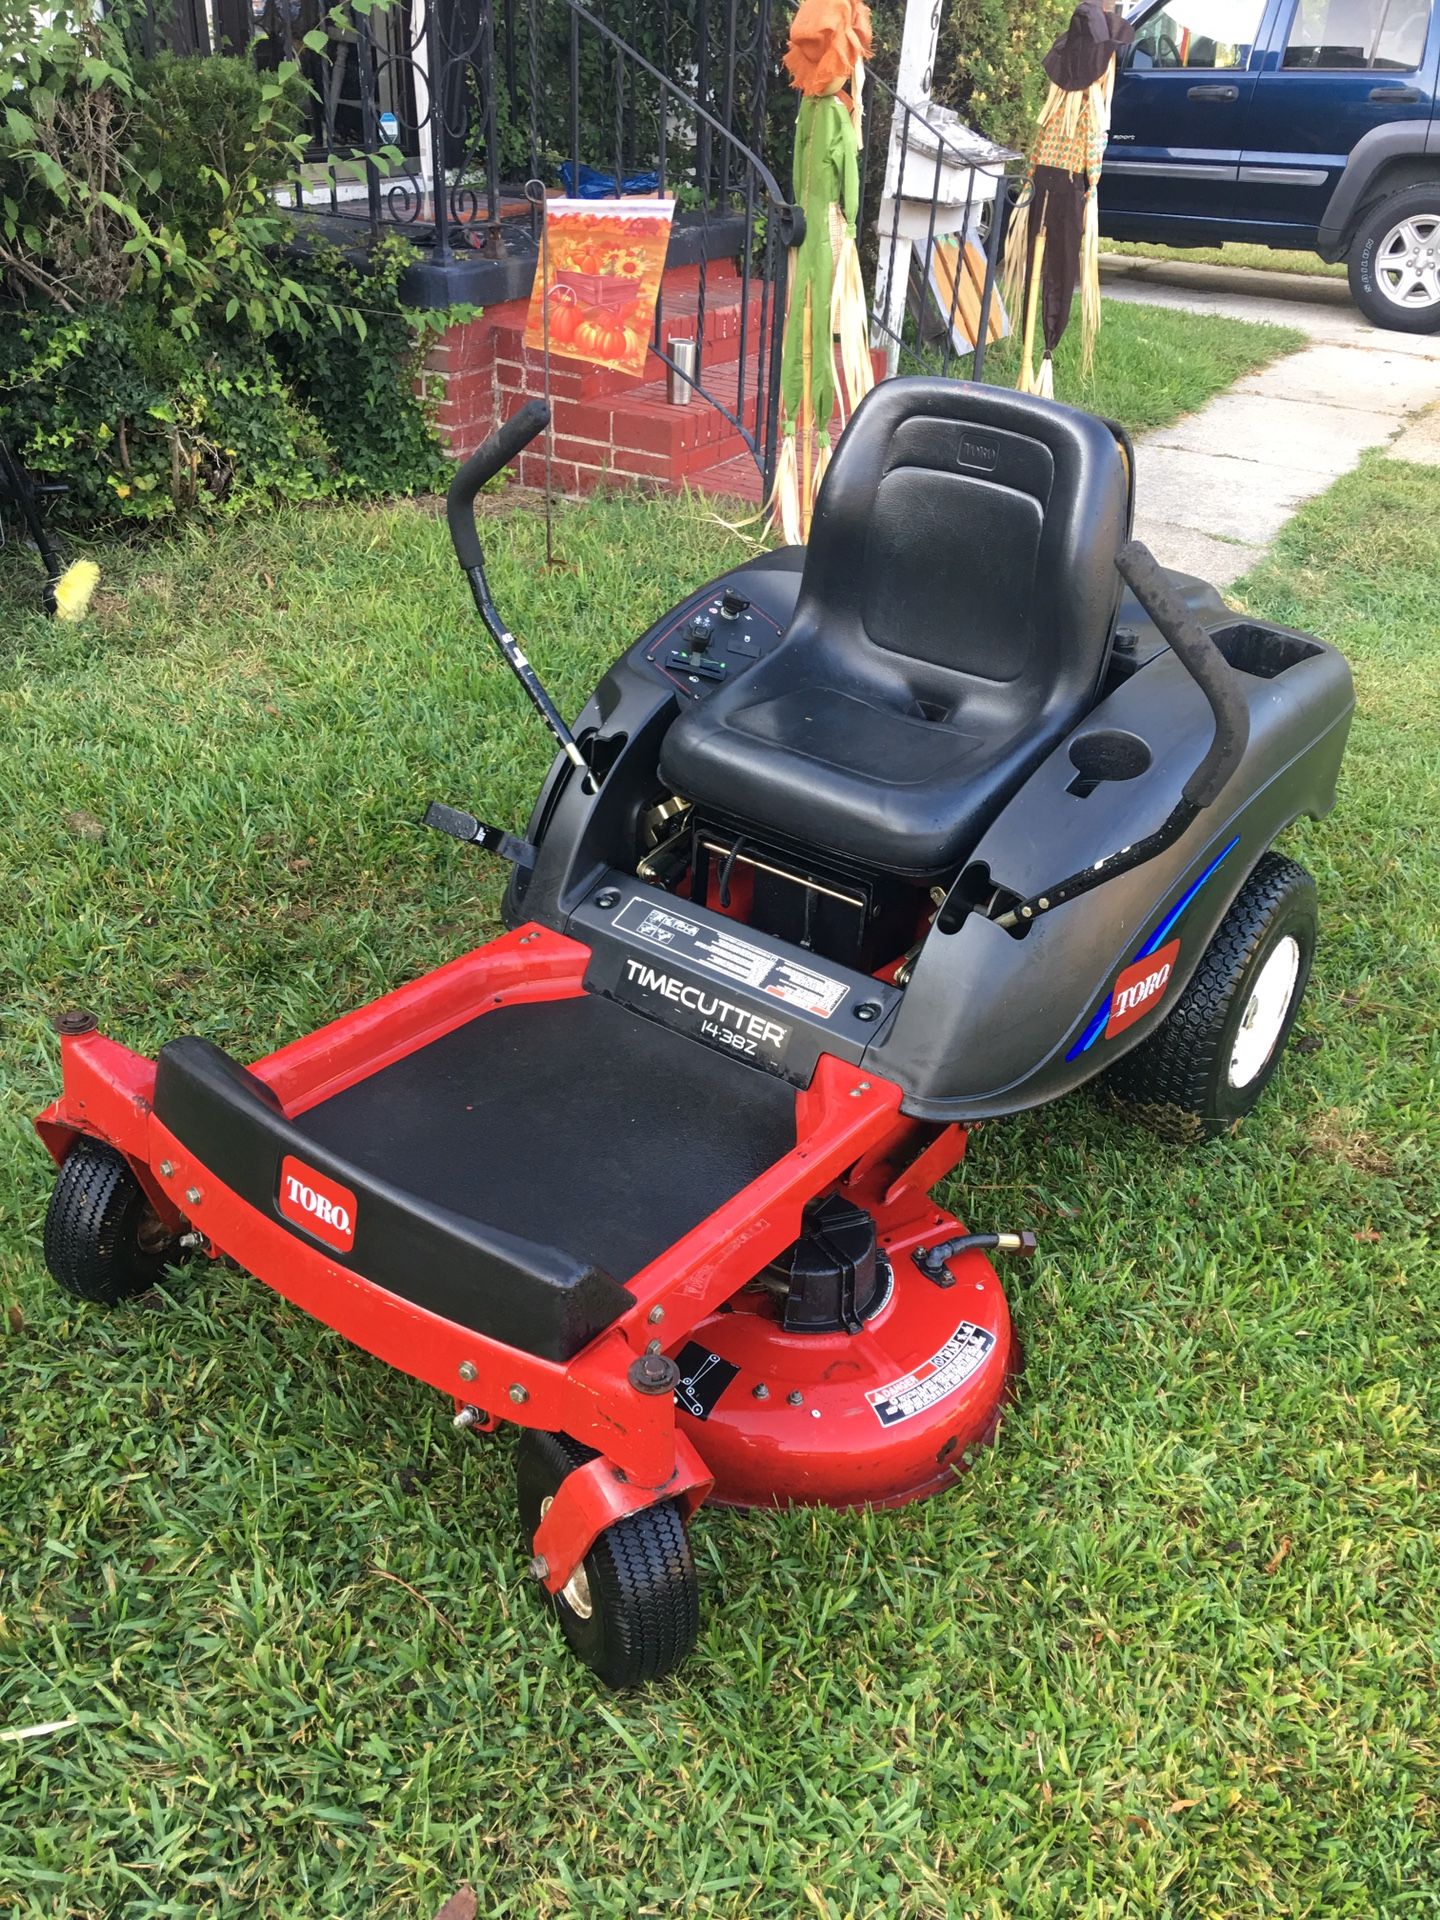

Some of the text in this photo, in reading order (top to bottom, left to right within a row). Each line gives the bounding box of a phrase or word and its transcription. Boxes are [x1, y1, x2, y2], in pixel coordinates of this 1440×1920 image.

[922, 0, 940, 94] 610
[963, 442, 996, 460] TORO
[626, 958, 785, 1049] TIMECUTTER
[1115, 963, 1170, 1018] TORO
[286, 1175, 352, 1235] TORO
